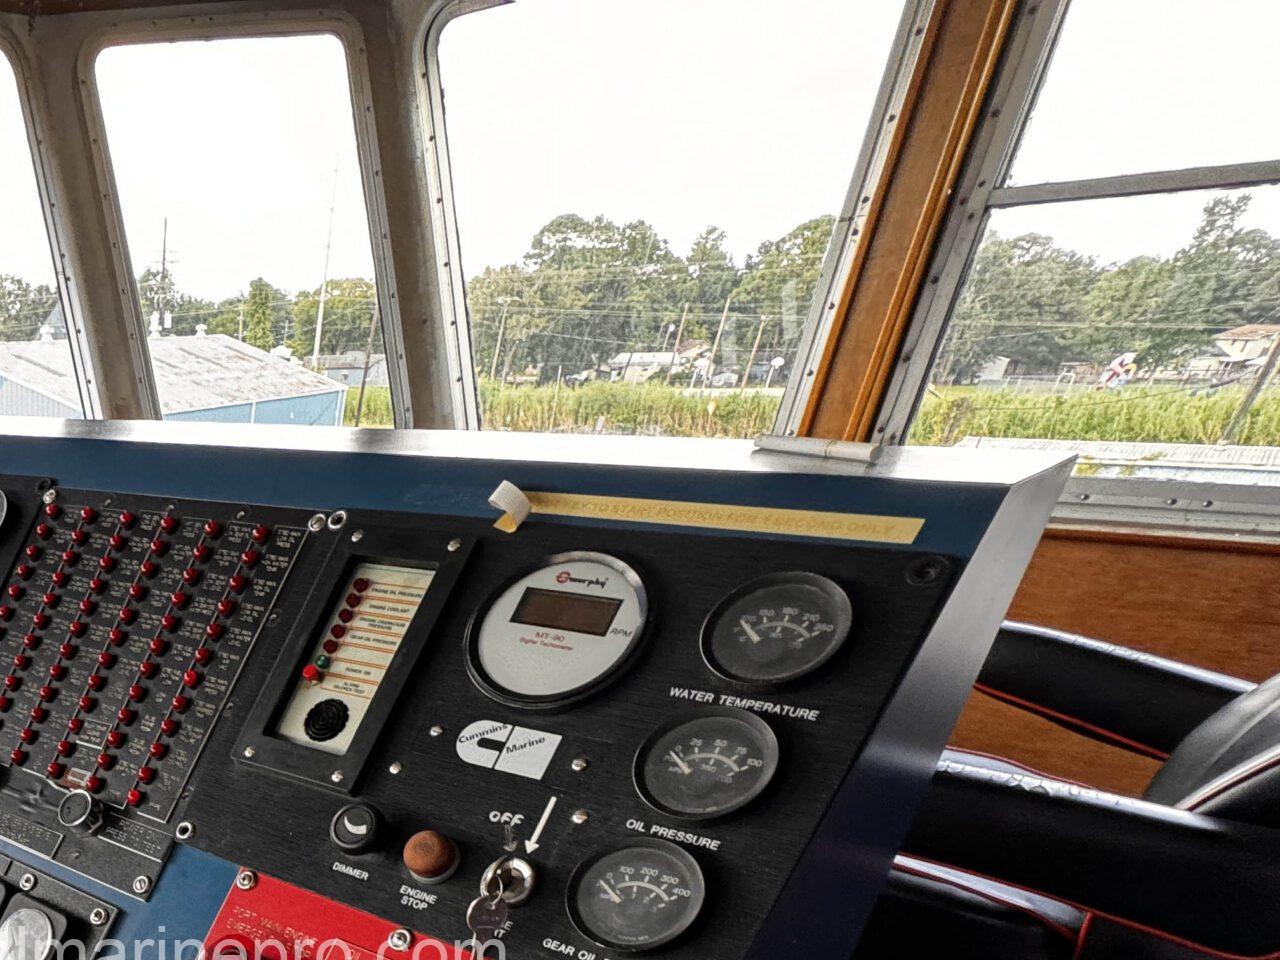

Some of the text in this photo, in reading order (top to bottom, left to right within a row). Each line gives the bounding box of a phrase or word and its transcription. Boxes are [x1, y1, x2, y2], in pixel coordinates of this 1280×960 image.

[610, 627, 632, 637] RPM
[670, 687, 820, 721] WATER TEMPERATURE
[458, 724, 546, 754] Cummins Marine
[690, 738, 703, 746] 25
[747, 759, 763, 767] 100
[488, 810, 524, 826] OFF
[626, 819, 722, 851] OIL PRESSURE
[332, 862, 369, 881] DIMMER
[620, 865, 634, 875] 100
[640, 867, 658, 876] 200
[660, 874, 679, 884] 300
[399, 884, 438, 905] ENGINE
[671, 888, 691, 897] 400
[400, 895, 428, 911] STOP
[542, 938, 576, 956] GEAR
